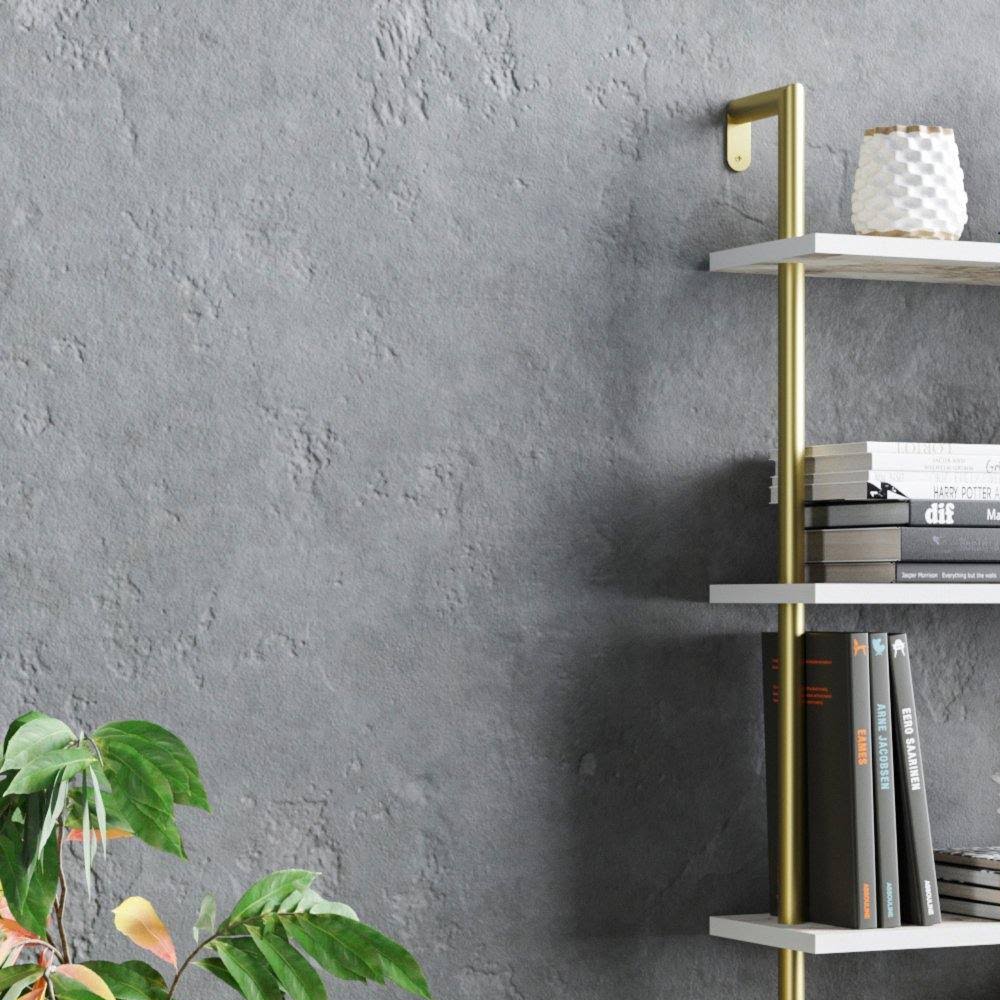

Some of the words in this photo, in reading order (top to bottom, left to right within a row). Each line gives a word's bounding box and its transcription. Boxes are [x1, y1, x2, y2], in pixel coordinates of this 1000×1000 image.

[933, 486, 957, 500] HARRY
[962, 486, 992, 500] POTTER
[925, 503, 955, 524] dif
[876, 703, 887, 734] ARNE
[901, 707, 914, 735] EERO
[857, 728, 868, 766] EAMES
[878, 736, 889, 790] JACOBSEN
[905, 737, 921, 791] SAARINEN
[923, 879, 934, 916] ASSOULINE
